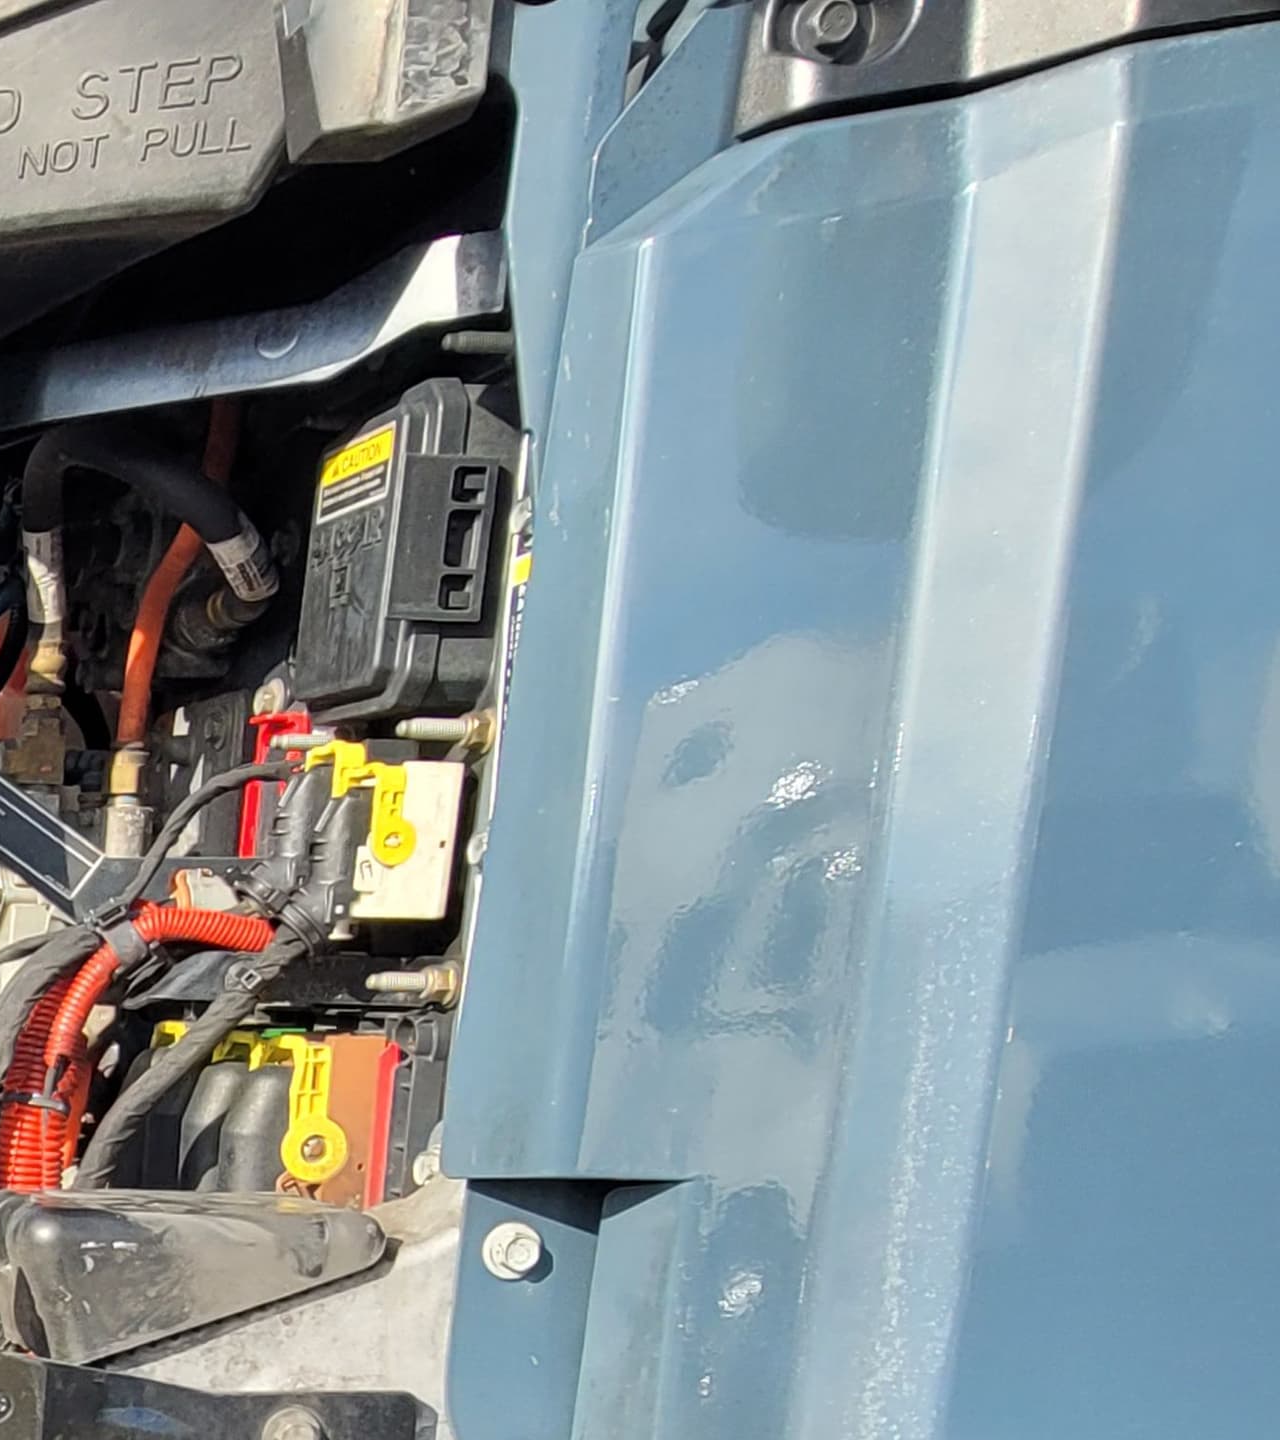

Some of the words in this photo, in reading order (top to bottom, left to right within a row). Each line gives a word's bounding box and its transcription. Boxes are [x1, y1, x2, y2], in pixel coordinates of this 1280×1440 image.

[71, 54, 244, 121] STEP
[17, 133, 111, 180] NOT
[139, 117, 252, 163] PULL
[342, 443, 382, 473] CAUTION
